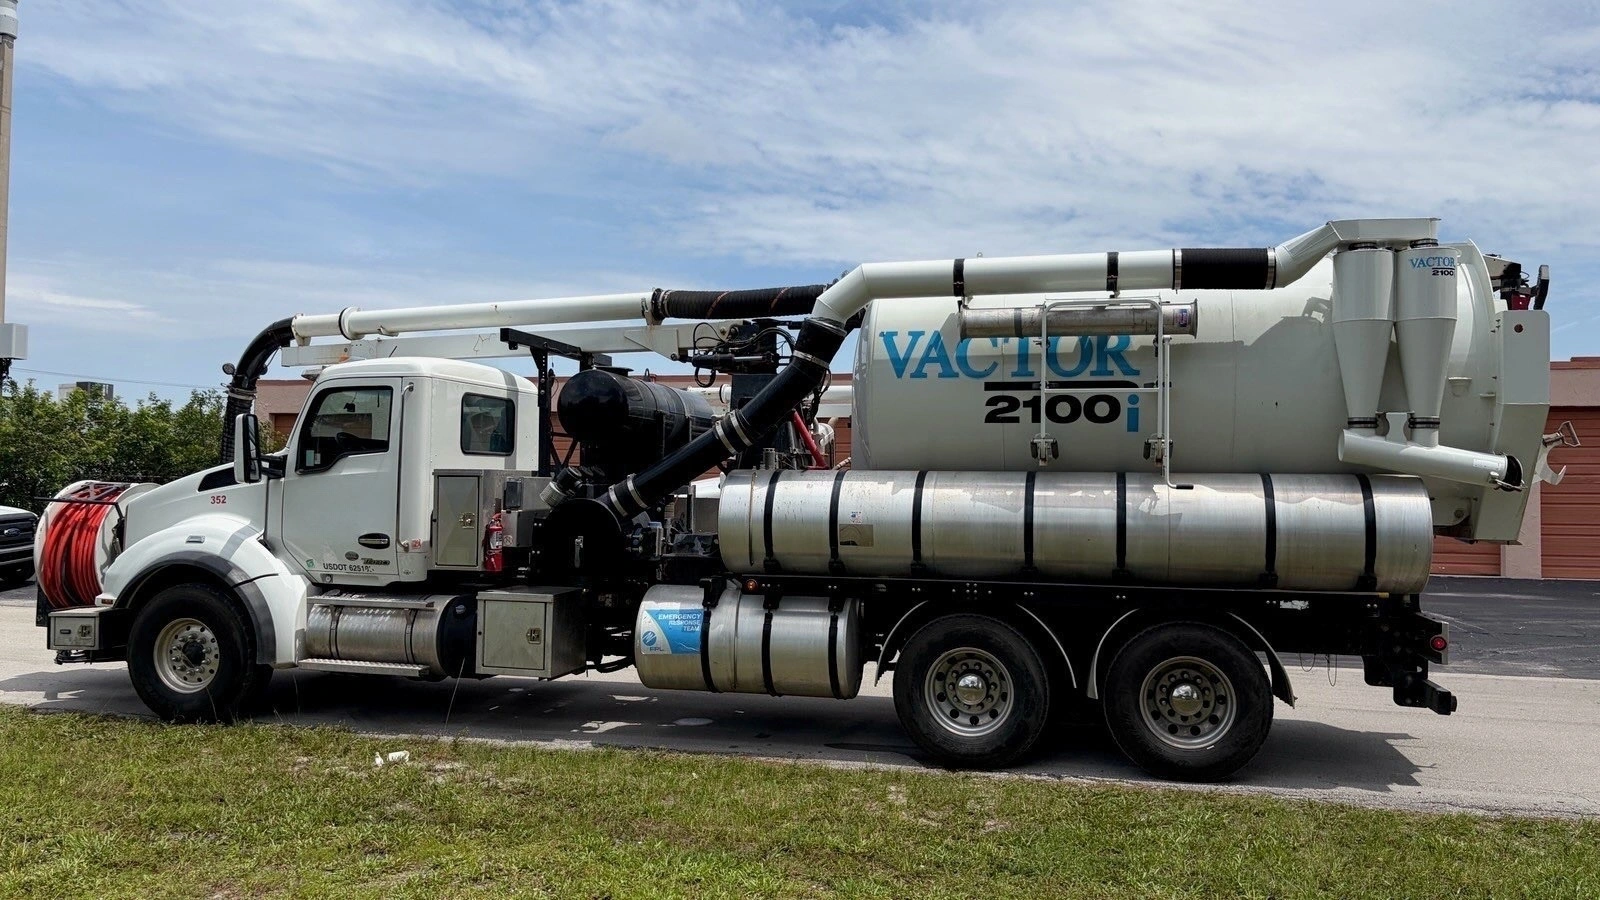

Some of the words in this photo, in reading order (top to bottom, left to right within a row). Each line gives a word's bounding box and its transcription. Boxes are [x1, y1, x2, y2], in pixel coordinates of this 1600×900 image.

[1409, 256, 1456, 268] VACTOR
[878, 329, 1141, 379] VACTOR
[210, 495, 227, 504] 352
[322, 562, 347, 571] USDOT
